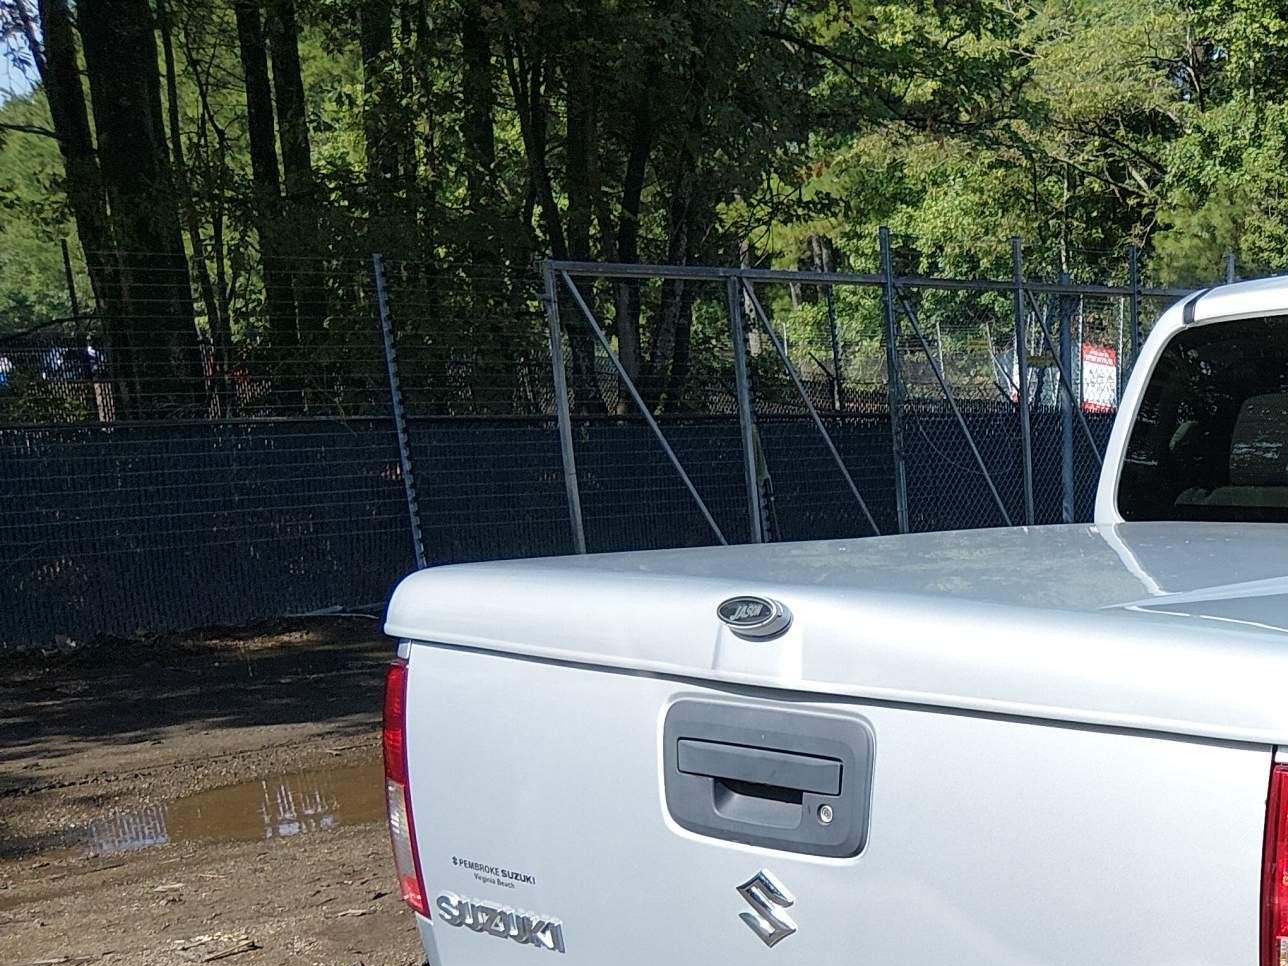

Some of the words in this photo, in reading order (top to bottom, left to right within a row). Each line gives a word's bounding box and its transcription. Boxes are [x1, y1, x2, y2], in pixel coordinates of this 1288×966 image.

[459, 858, 500, 876] PEMBROKE
[501, 869, 536, 885] SUZUKI
[474, 873, 496, 884] Virginia
[497, 878, 515, 889] Beach
[436, 892, 566, 954] SUZUKI
